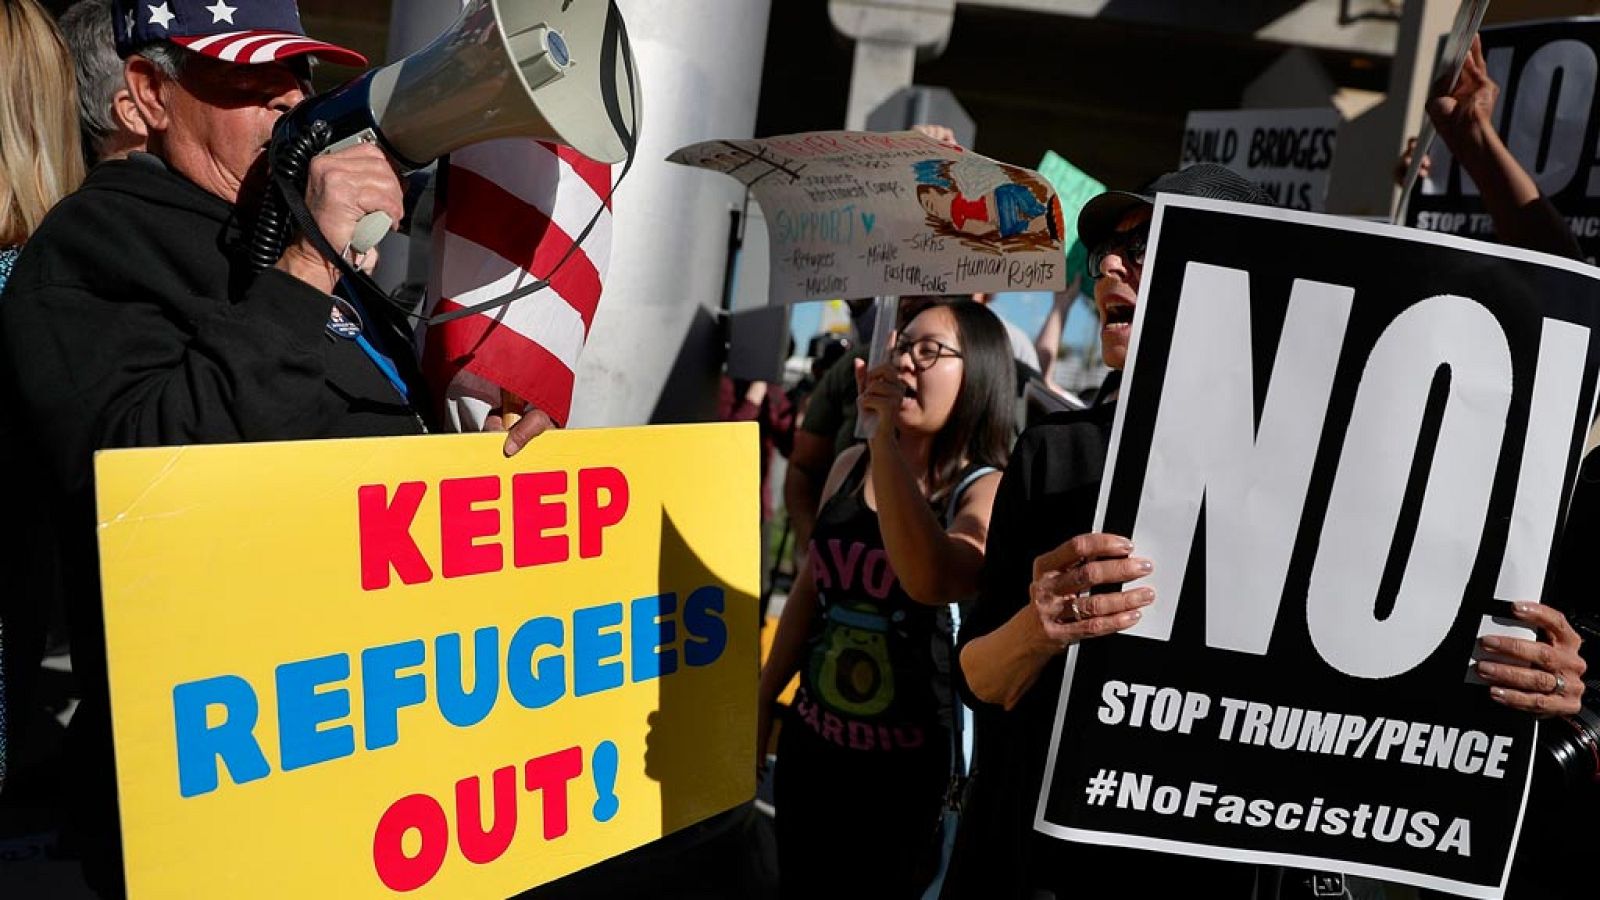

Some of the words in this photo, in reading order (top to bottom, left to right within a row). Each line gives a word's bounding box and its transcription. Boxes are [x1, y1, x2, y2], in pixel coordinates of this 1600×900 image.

[1184, 129, 1237, 163] BUILD
[1248, 127, 1336, 170] BRIDGES
[777, 204, 858, 244] SUPPORT
[1416, 210, 1466, 232] STOP
[1007, 259, 1056, 288] Rights
[1117, 261, 1590, 684] NO!
[357, 466, 630, 591] KEEP
[172, 585, 727, 798] REFUGEES
[1097, 680, 1209, 735] STOP
[1219, 697, 1513, 779] TRUMP/PENCE
[373, 740, 619, 892] OUT!
[1085, 768, 1472, 857] #NoFascistUSA
